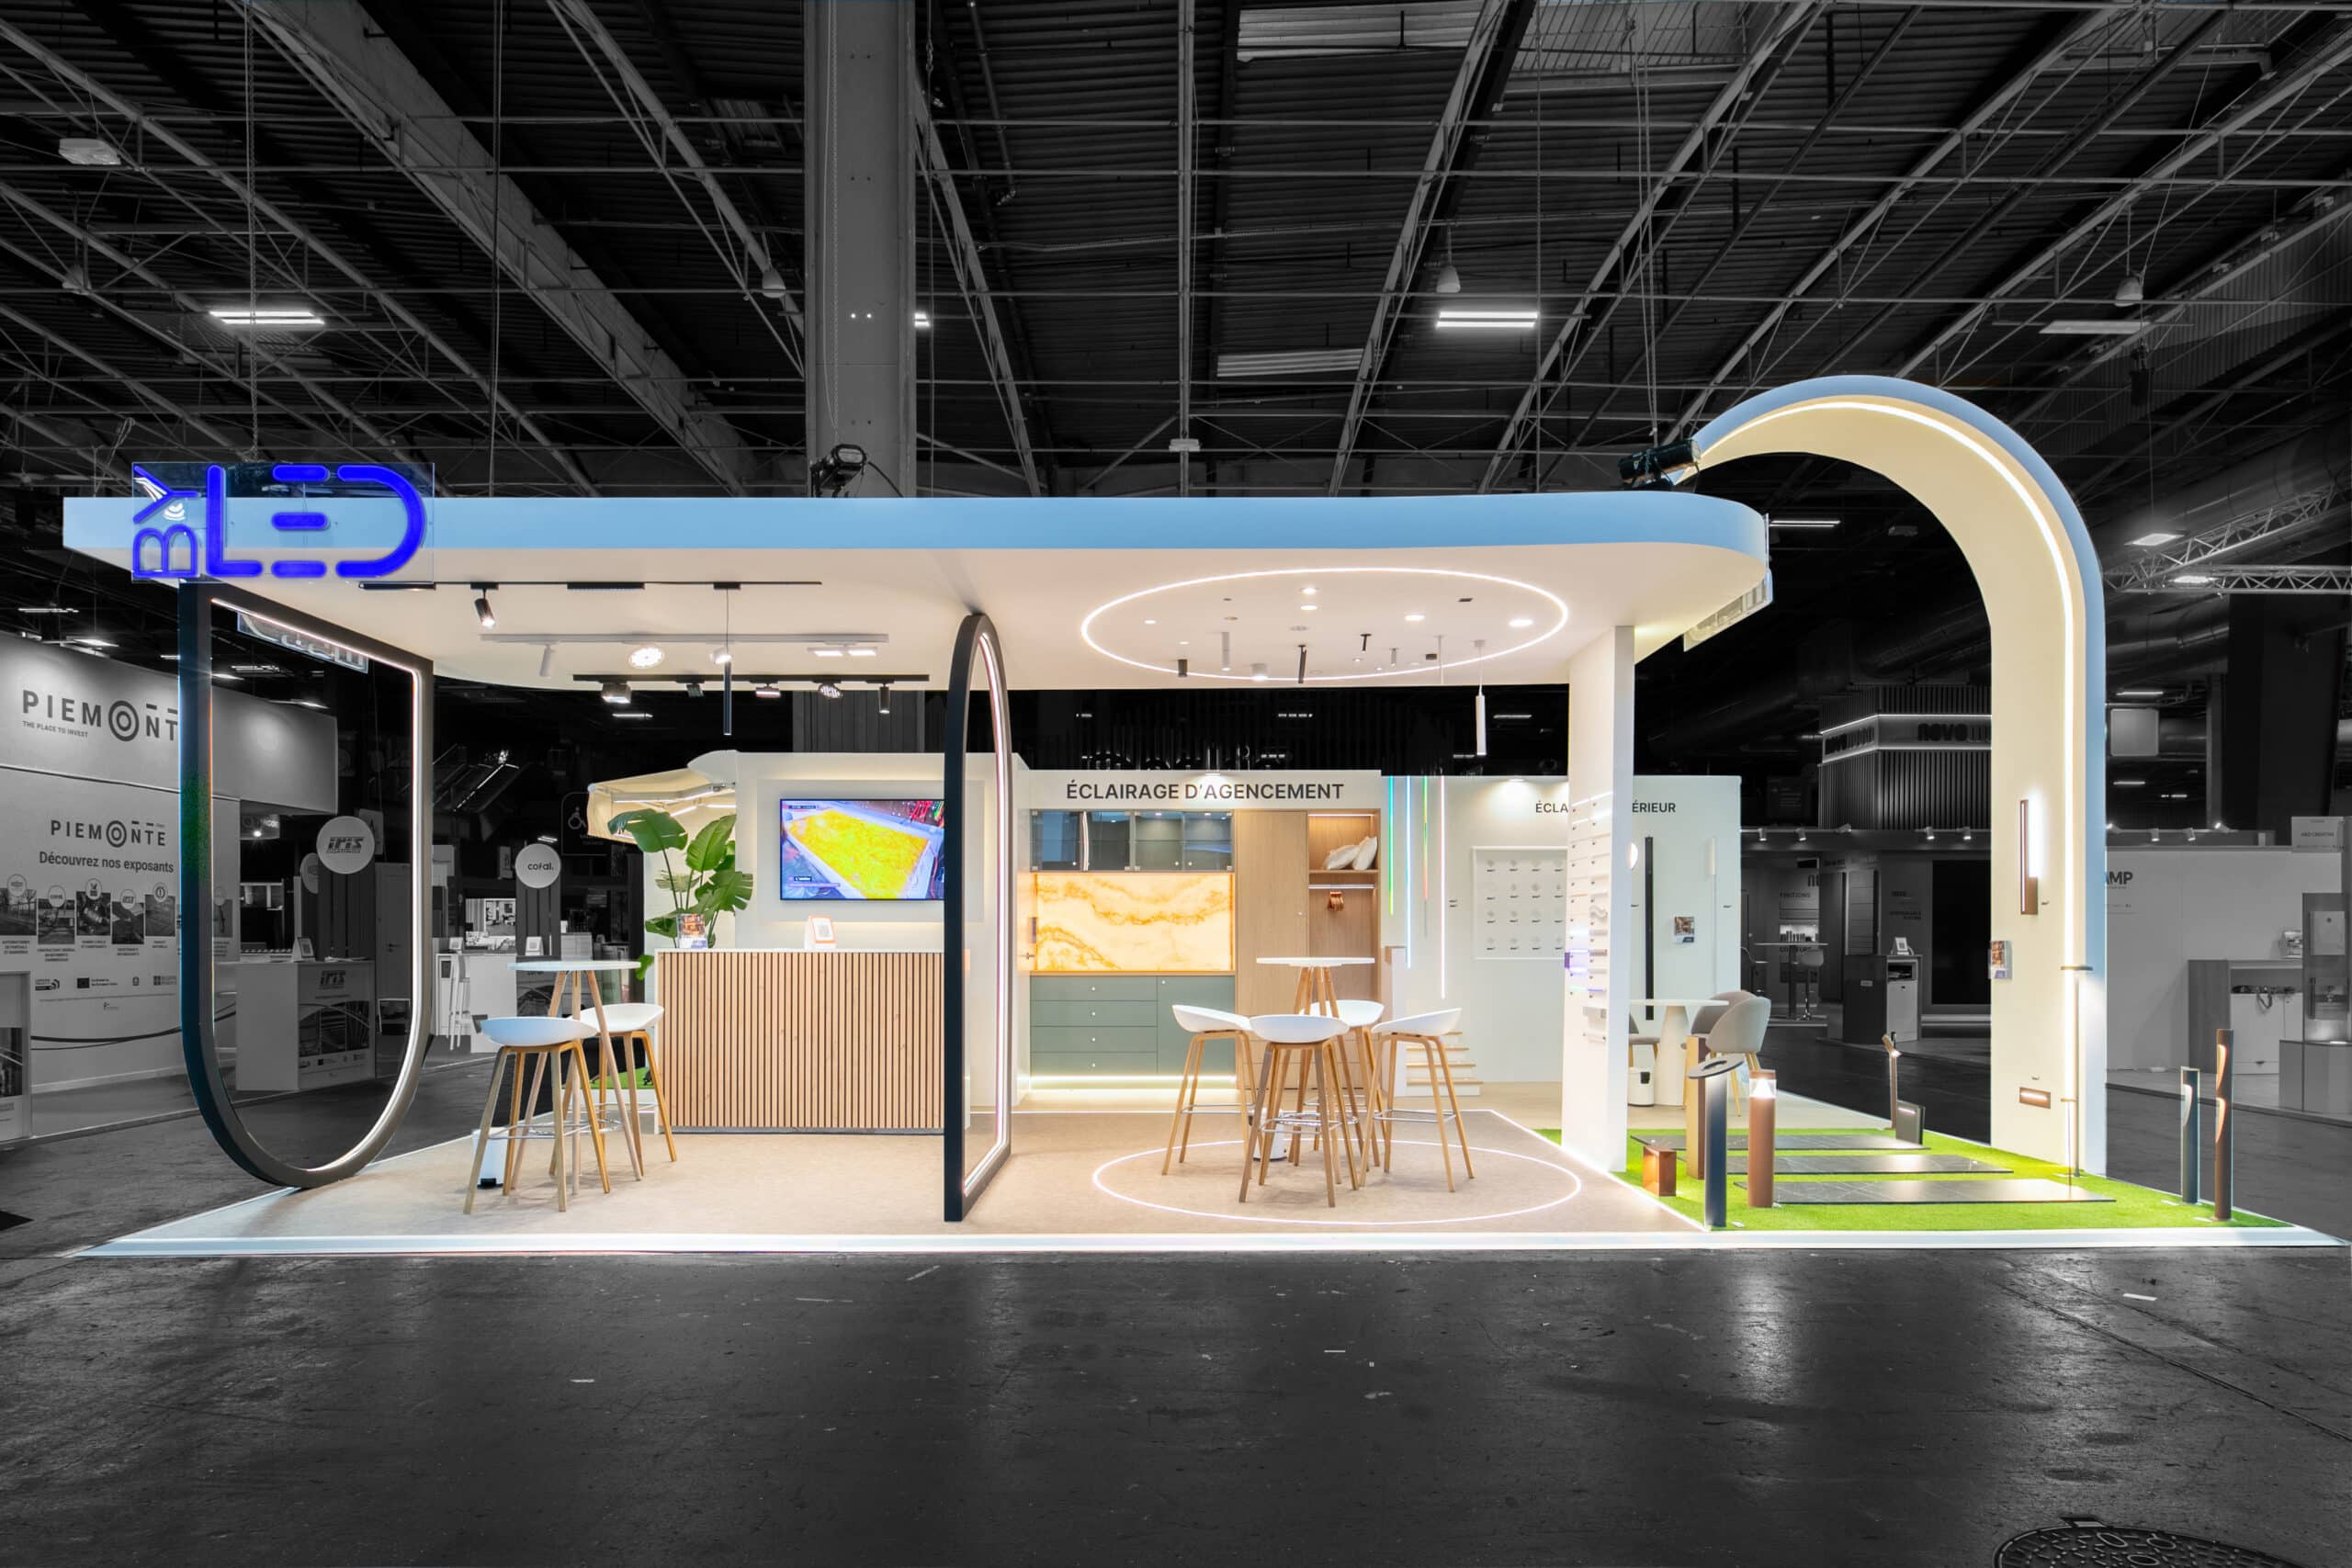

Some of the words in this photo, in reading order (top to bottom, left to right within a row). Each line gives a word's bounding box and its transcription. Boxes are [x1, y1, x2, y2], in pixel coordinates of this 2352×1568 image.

[133, 465, 200, 578] BY
[206, 464, 426, 578] LED
[22, 689, 178, 741] PIEMONT
[22, 720, 34, 728] THE
[37, 723, 56, 732] PLACE
[67, 728, 88, 738] INVEST
[1066, 779, 1179, 799] ÉCLAIRAGE
[1185, 783, 1344, 799] D'AGENCEMENT
[1535, 800, 1568, 813] ÉCLA
[1632, 799, 1676, 813] ÉRIEUR
[51, 819, 166, 848] PIEMONTE
[39, 851, 99, 868] Découvrez
[102, 858, 121, 869] nos
[124, 859, 175, 874] exposants
